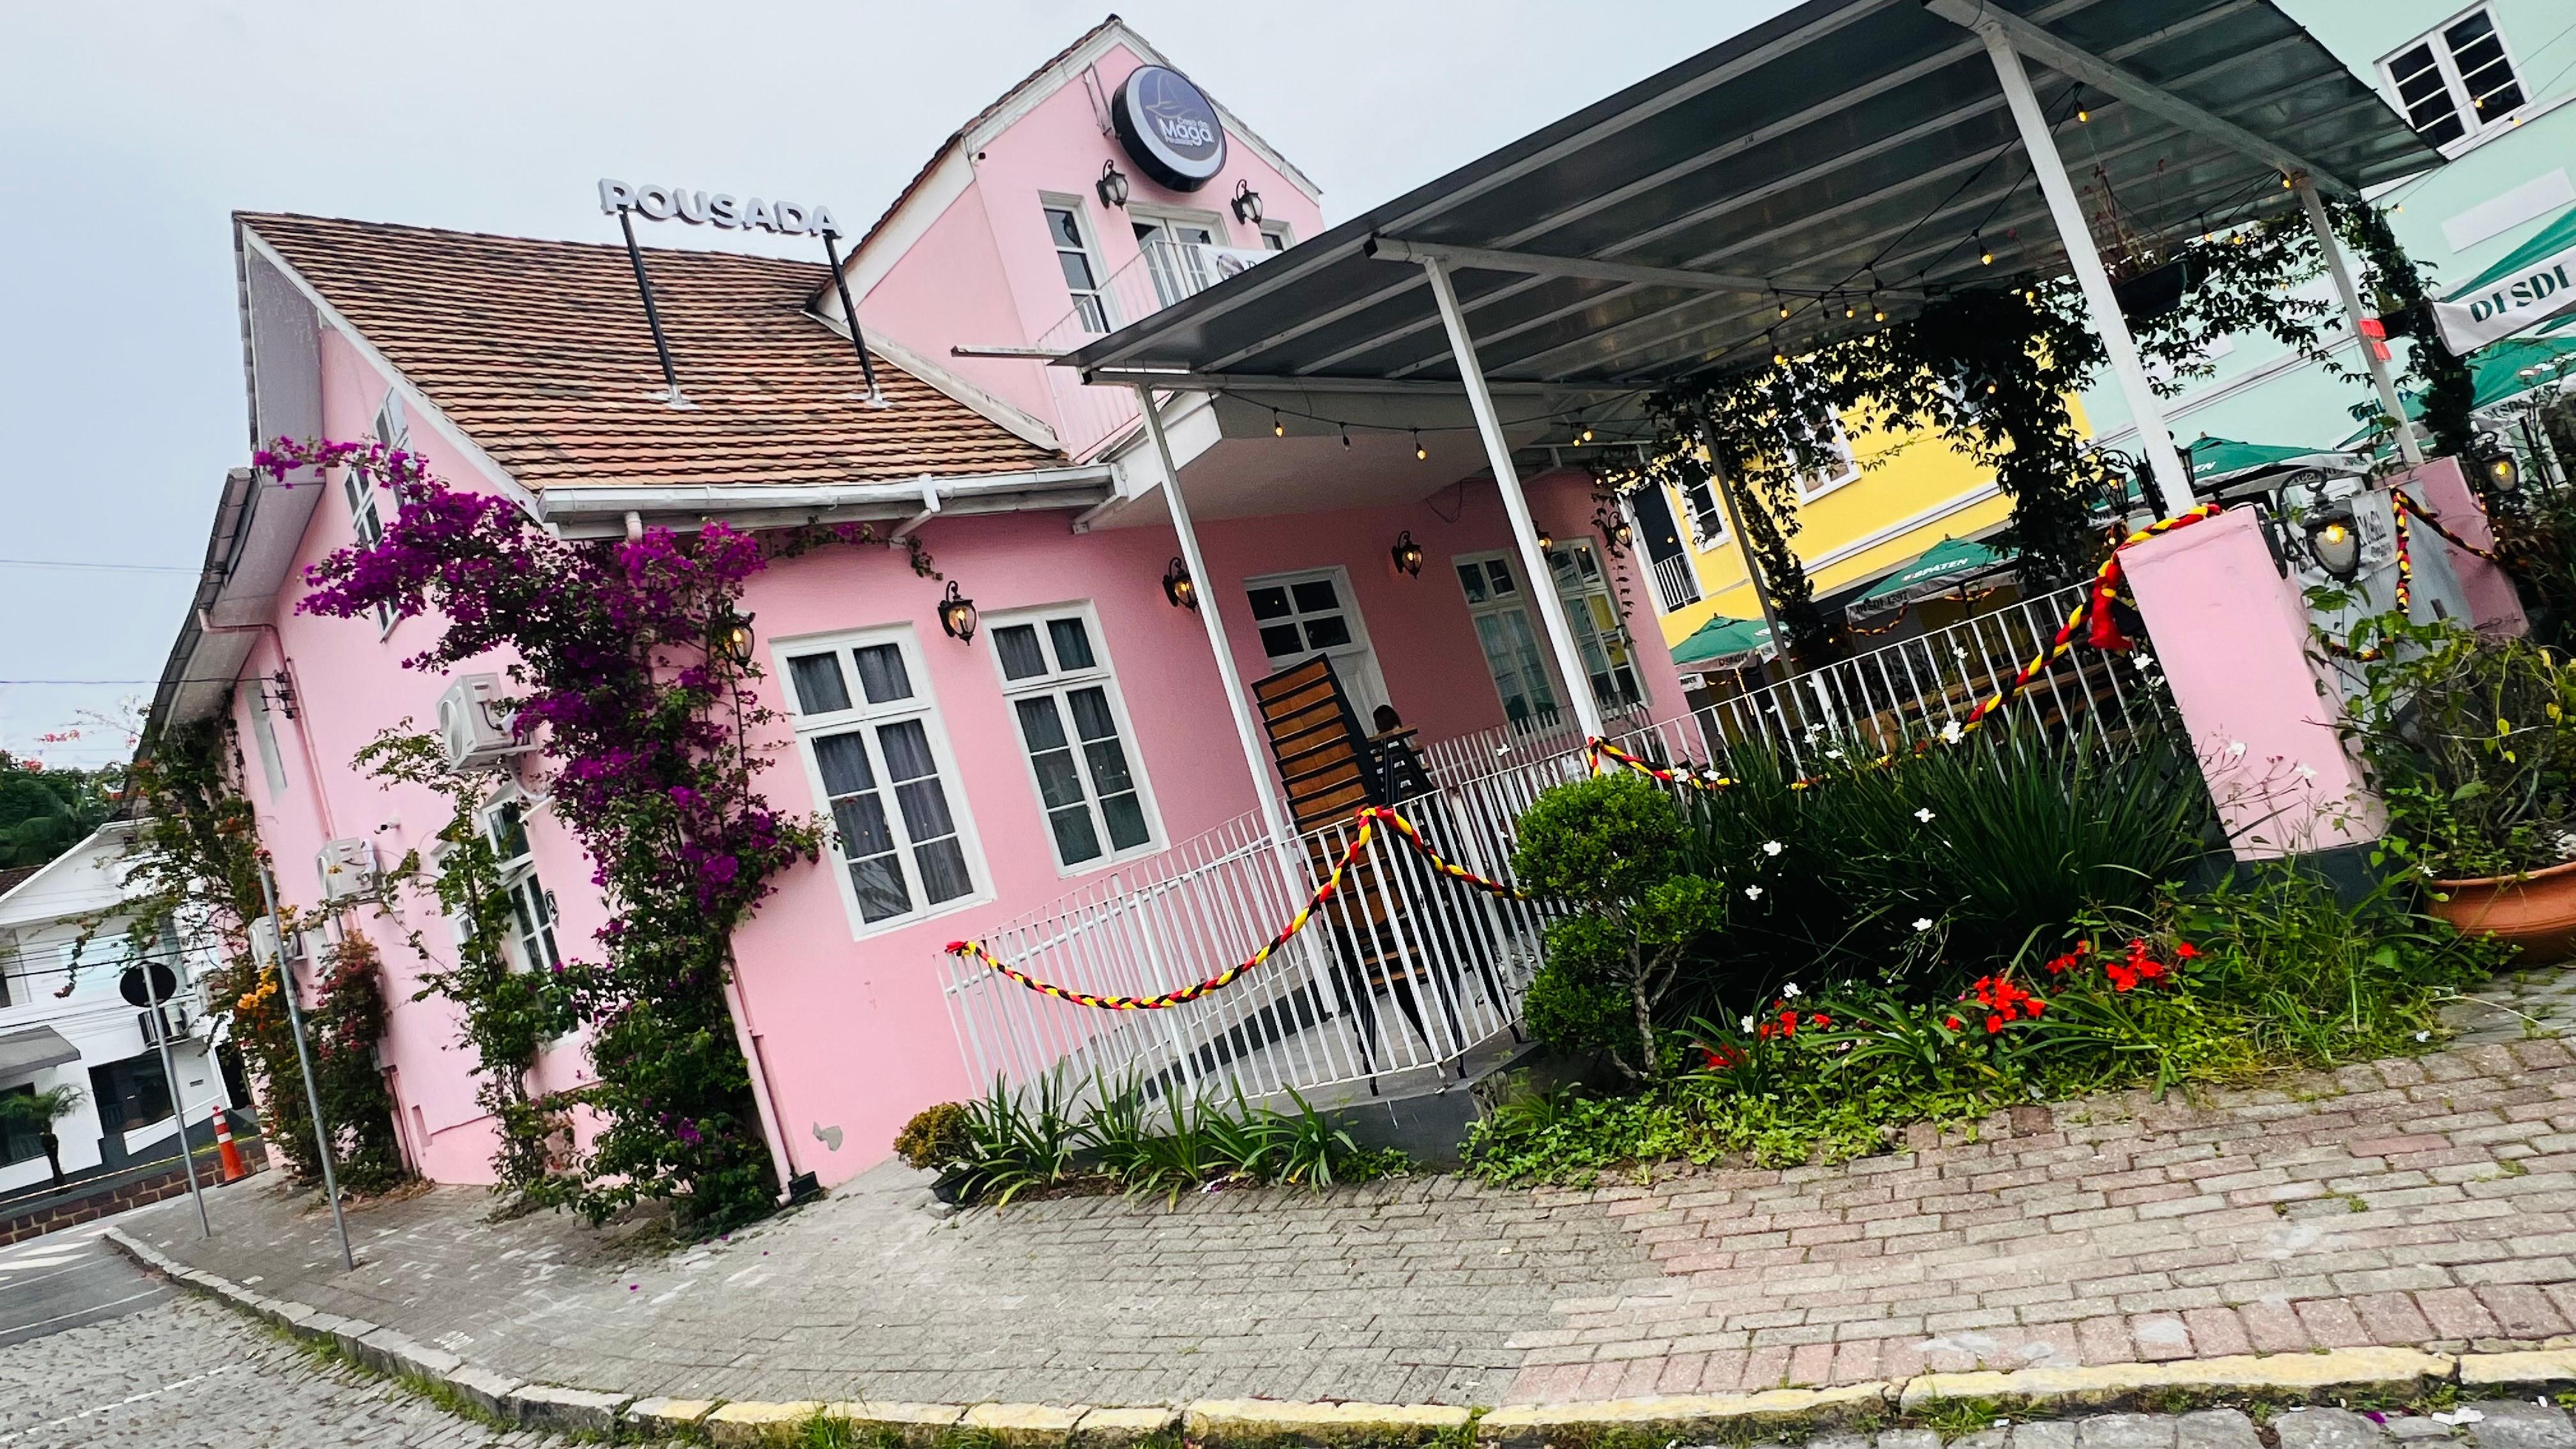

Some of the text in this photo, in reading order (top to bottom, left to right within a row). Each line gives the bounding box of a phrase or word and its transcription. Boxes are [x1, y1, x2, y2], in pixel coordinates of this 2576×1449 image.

[1159, 118, 1215, 146] Maga
[598, 178, 844, 238] POUSADA
[1912, 558, 1968, 579] SPATEN
